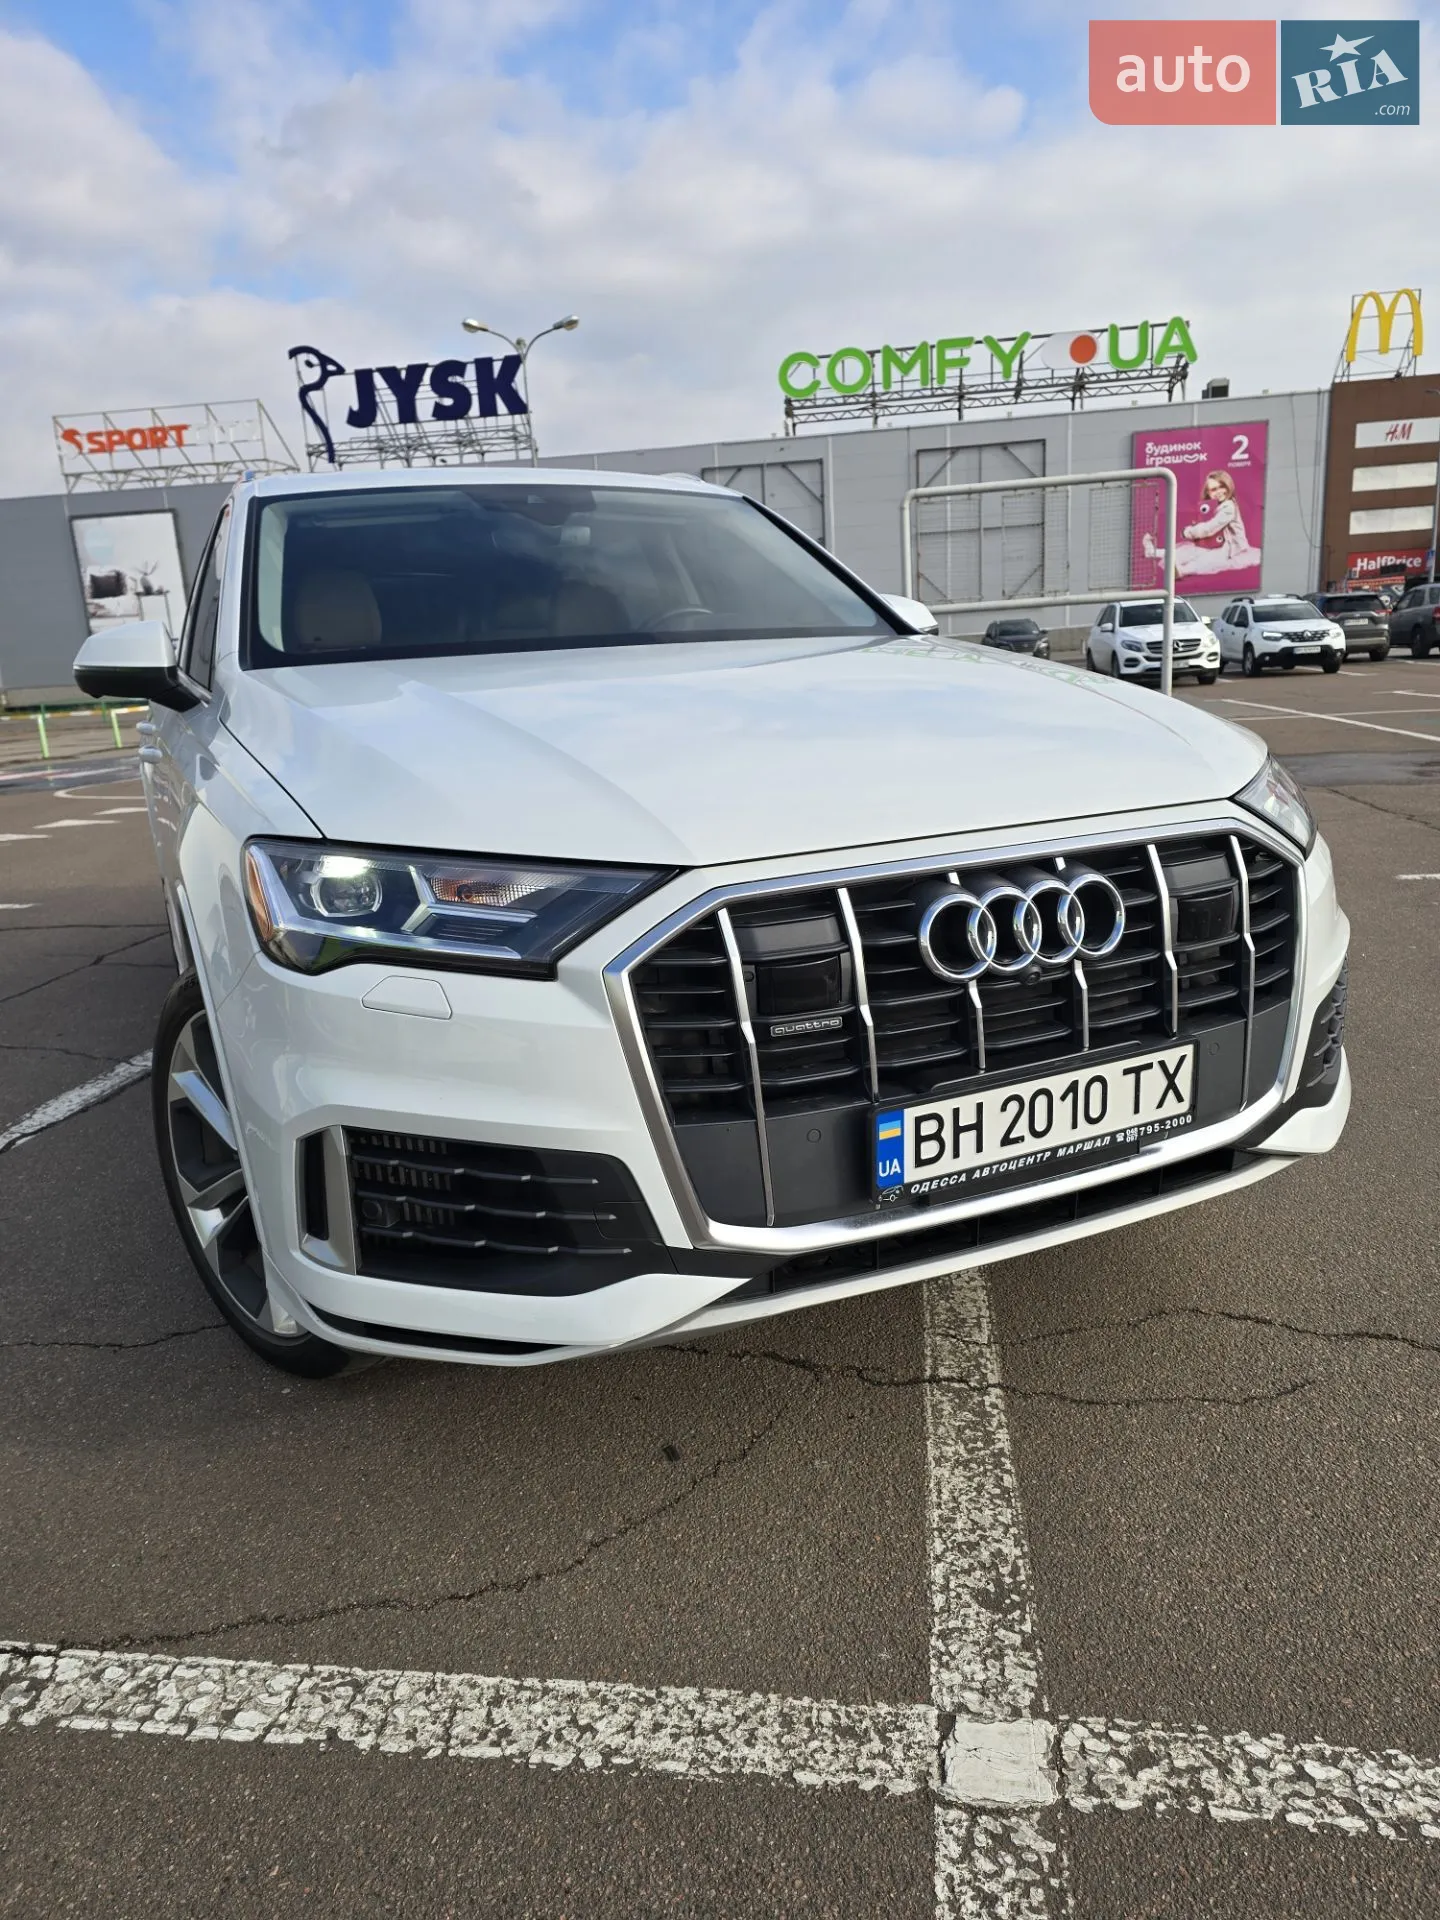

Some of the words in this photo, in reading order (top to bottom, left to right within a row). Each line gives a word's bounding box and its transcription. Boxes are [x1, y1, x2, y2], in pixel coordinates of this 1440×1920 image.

[778, 331, 1031, 398] COMFY
[1108, 316, 1198, 369] UA
[346, 354, 528, 428] JYSK
[86, 424, 191, 453] SPORT
[1145, 441, 1201, 455] будинок
[1231, 434, 1249, 460] 2
[774, 1019, 839, 1035] quattro
[914, 1101, 984, 1168] BH
[1000, 1074, 1108, 1147] 2010
[1122, 1054, 1188, 1115] TX
[910, 1174, 966, 1194] ОДЕССА
[972, 1151, 1052, 1179] АВТОЦЕНТР
[1056, 1135, 1111, 1158] МАРШАЛ
[1139, 1115, 1192, 1136] 795-2000
[879, 1162, 901, 1177] UA
